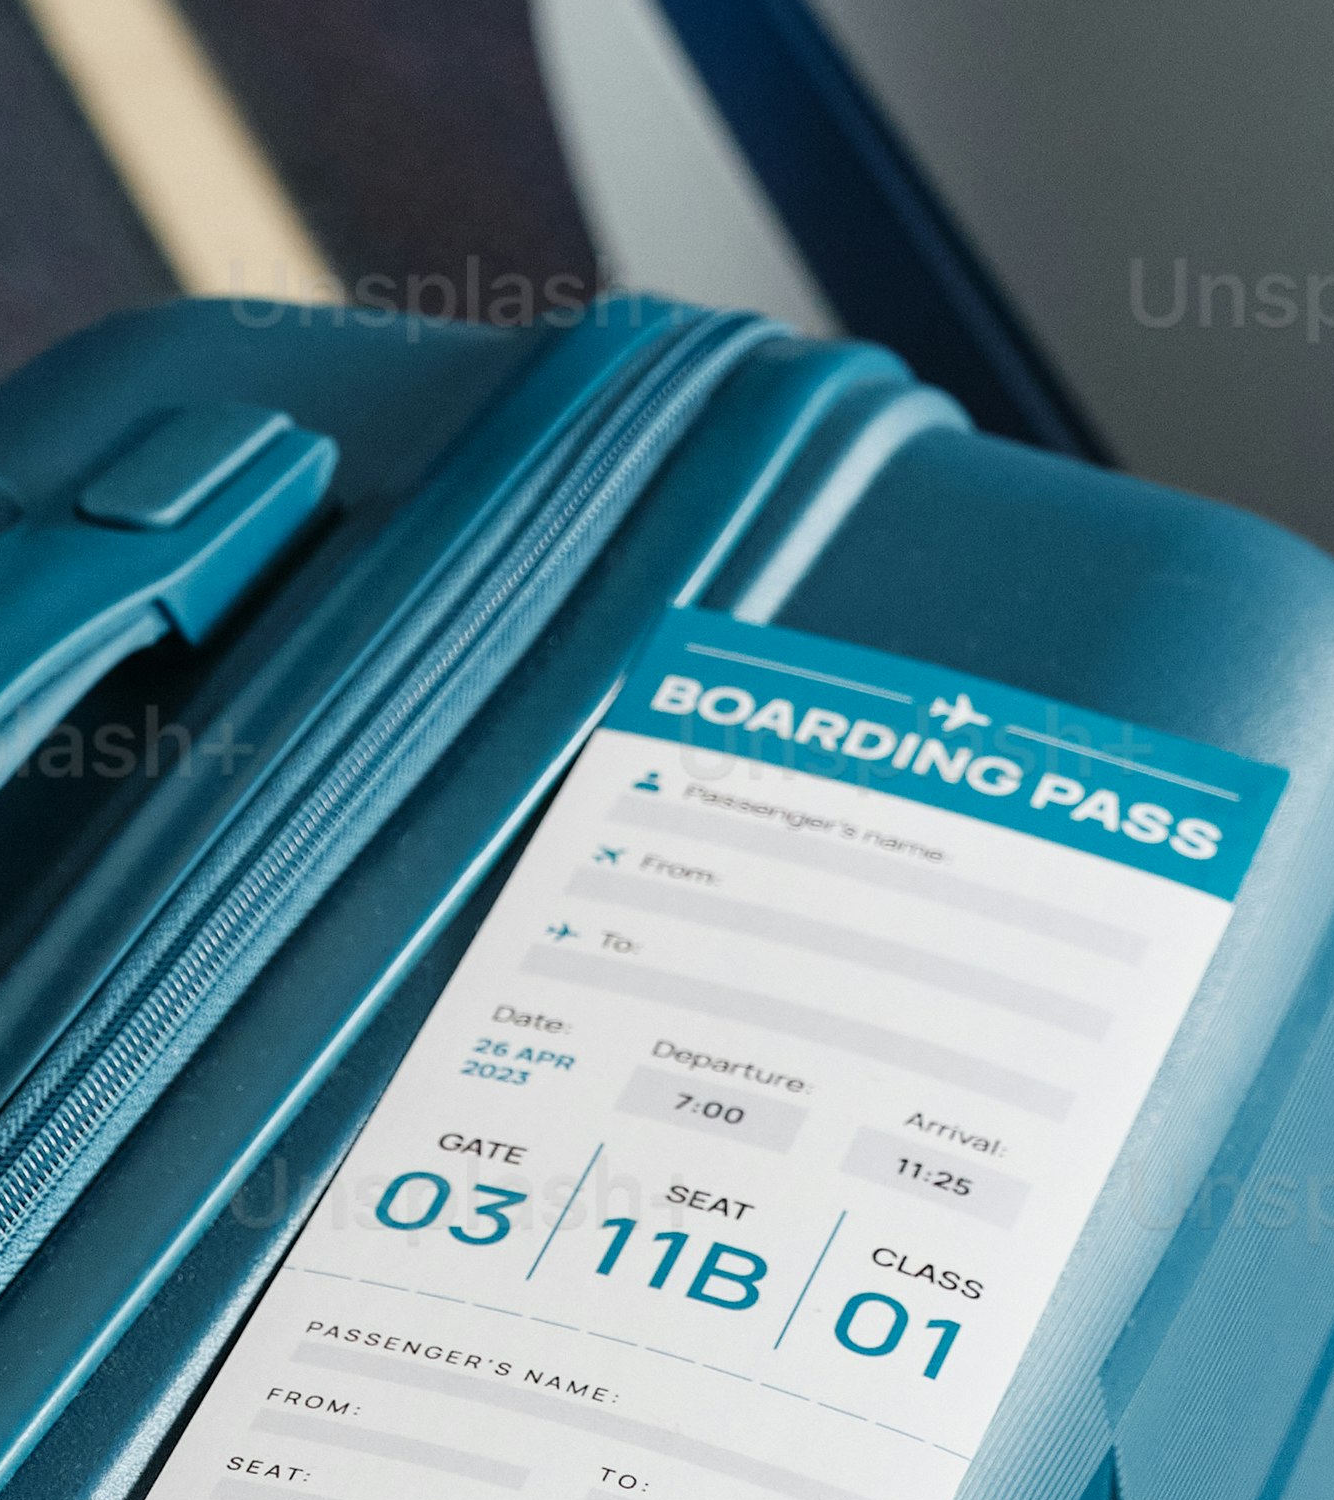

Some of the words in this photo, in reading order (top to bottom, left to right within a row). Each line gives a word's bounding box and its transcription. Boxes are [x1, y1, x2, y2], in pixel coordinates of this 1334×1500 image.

[650, 675, 1022, 797] BOARDING
[1029, 772, 1225, 862] PASS
[682, 782, 858, 840] Passenger's
[638, 854, 722, 887] From:
[601, 929, 643, 956] To:
[490, 1003, 574, 1036] Date:
[460, 1059, 532, 1088] 2023
[471, 1037, 510, 1059] 26
[515, 1045, 576, 1072] APR
[651, 1038, 816, 1097] Departure:
[673, 1092, 747, 1126] 7:00
[437, 1132, 529, 1167] GATE
[904, 1111, 1009, 1159] Arrival:
[895, 1157, 975, 1198] 11:25
[373, 1170, 529, 1247] 03
[664, 1183, 757, 1223] SEAT
[594, 1216, 769, 1313] 11B
[870, 1246, 985, 1302] CLASS
[833, 1291, 964, 1382] 01
[304, 1319, 514, 1378] PASSENGER'S
[523, 1367, 621, 1405] NAME:
[265, 1387, 363, 1417] FROM:
[225, 1456, 312, 1483] SEAT:
[598, 1466, 651, 1493] TO:
